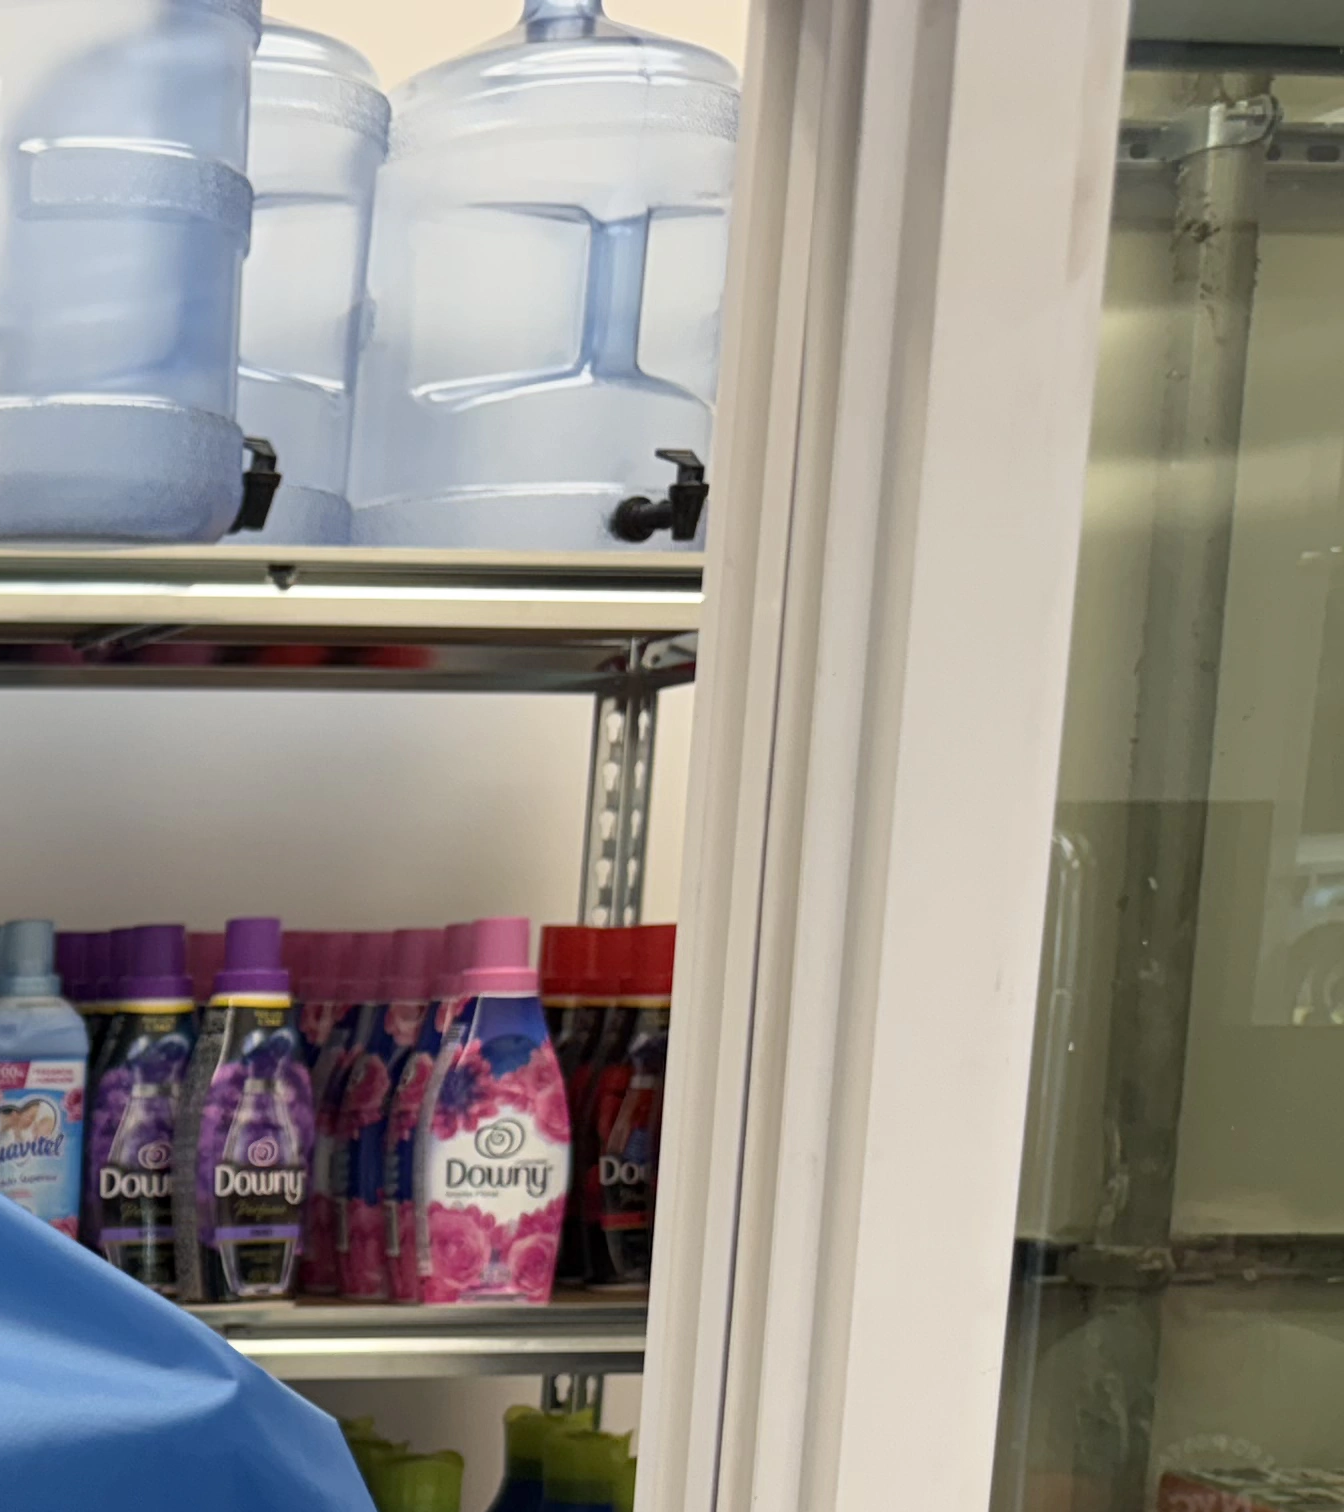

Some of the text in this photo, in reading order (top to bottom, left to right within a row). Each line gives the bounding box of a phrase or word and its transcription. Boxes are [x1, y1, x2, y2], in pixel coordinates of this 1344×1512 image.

[100, 1167, 174, 1198] Dow
[215, 1164, 307, 1205] Downy
[445, 1158, 548, 1198] Downy
